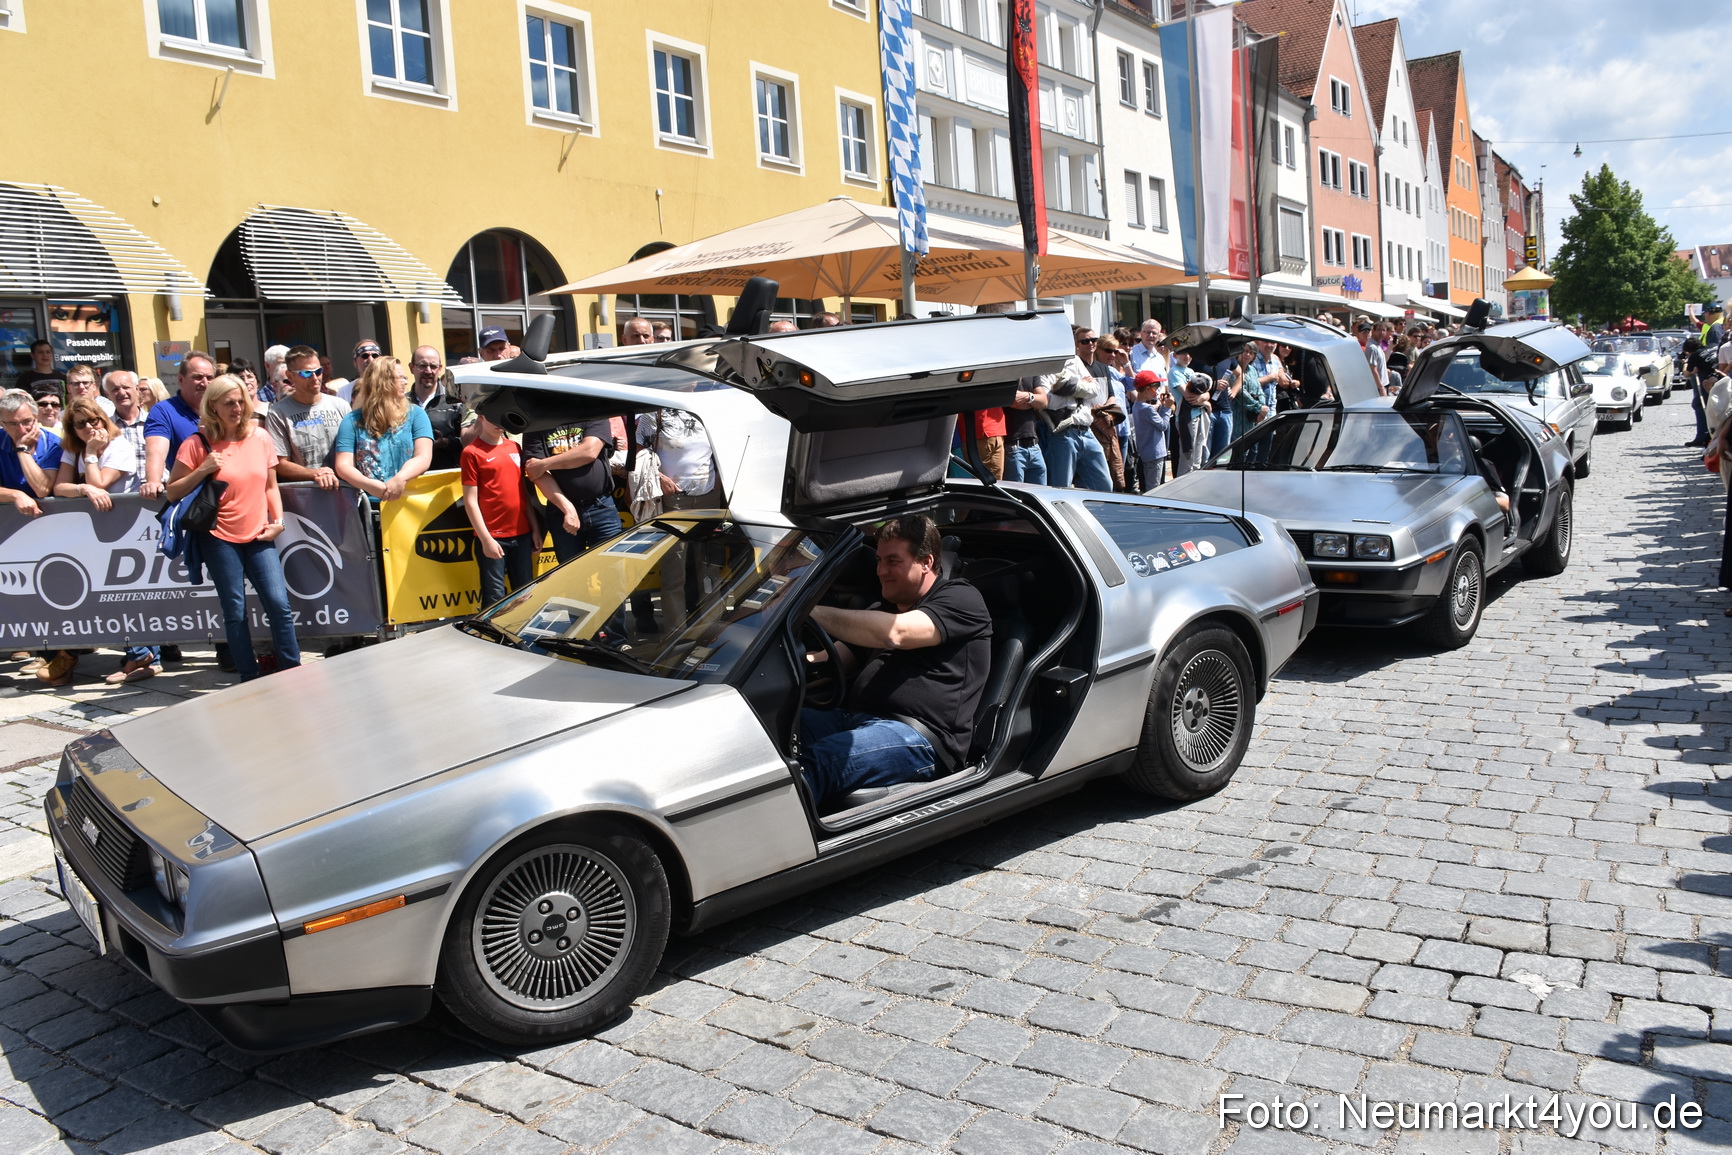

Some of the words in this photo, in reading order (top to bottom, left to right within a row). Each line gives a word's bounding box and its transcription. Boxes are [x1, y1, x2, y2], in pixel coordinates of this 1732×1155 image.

[66, 338, 107, 347] Passbilder
[320, 410, 339, 419] SAM
[104, 548, 213, 587] Die
[98, 590, 187, 603] BREITENBRUNN
